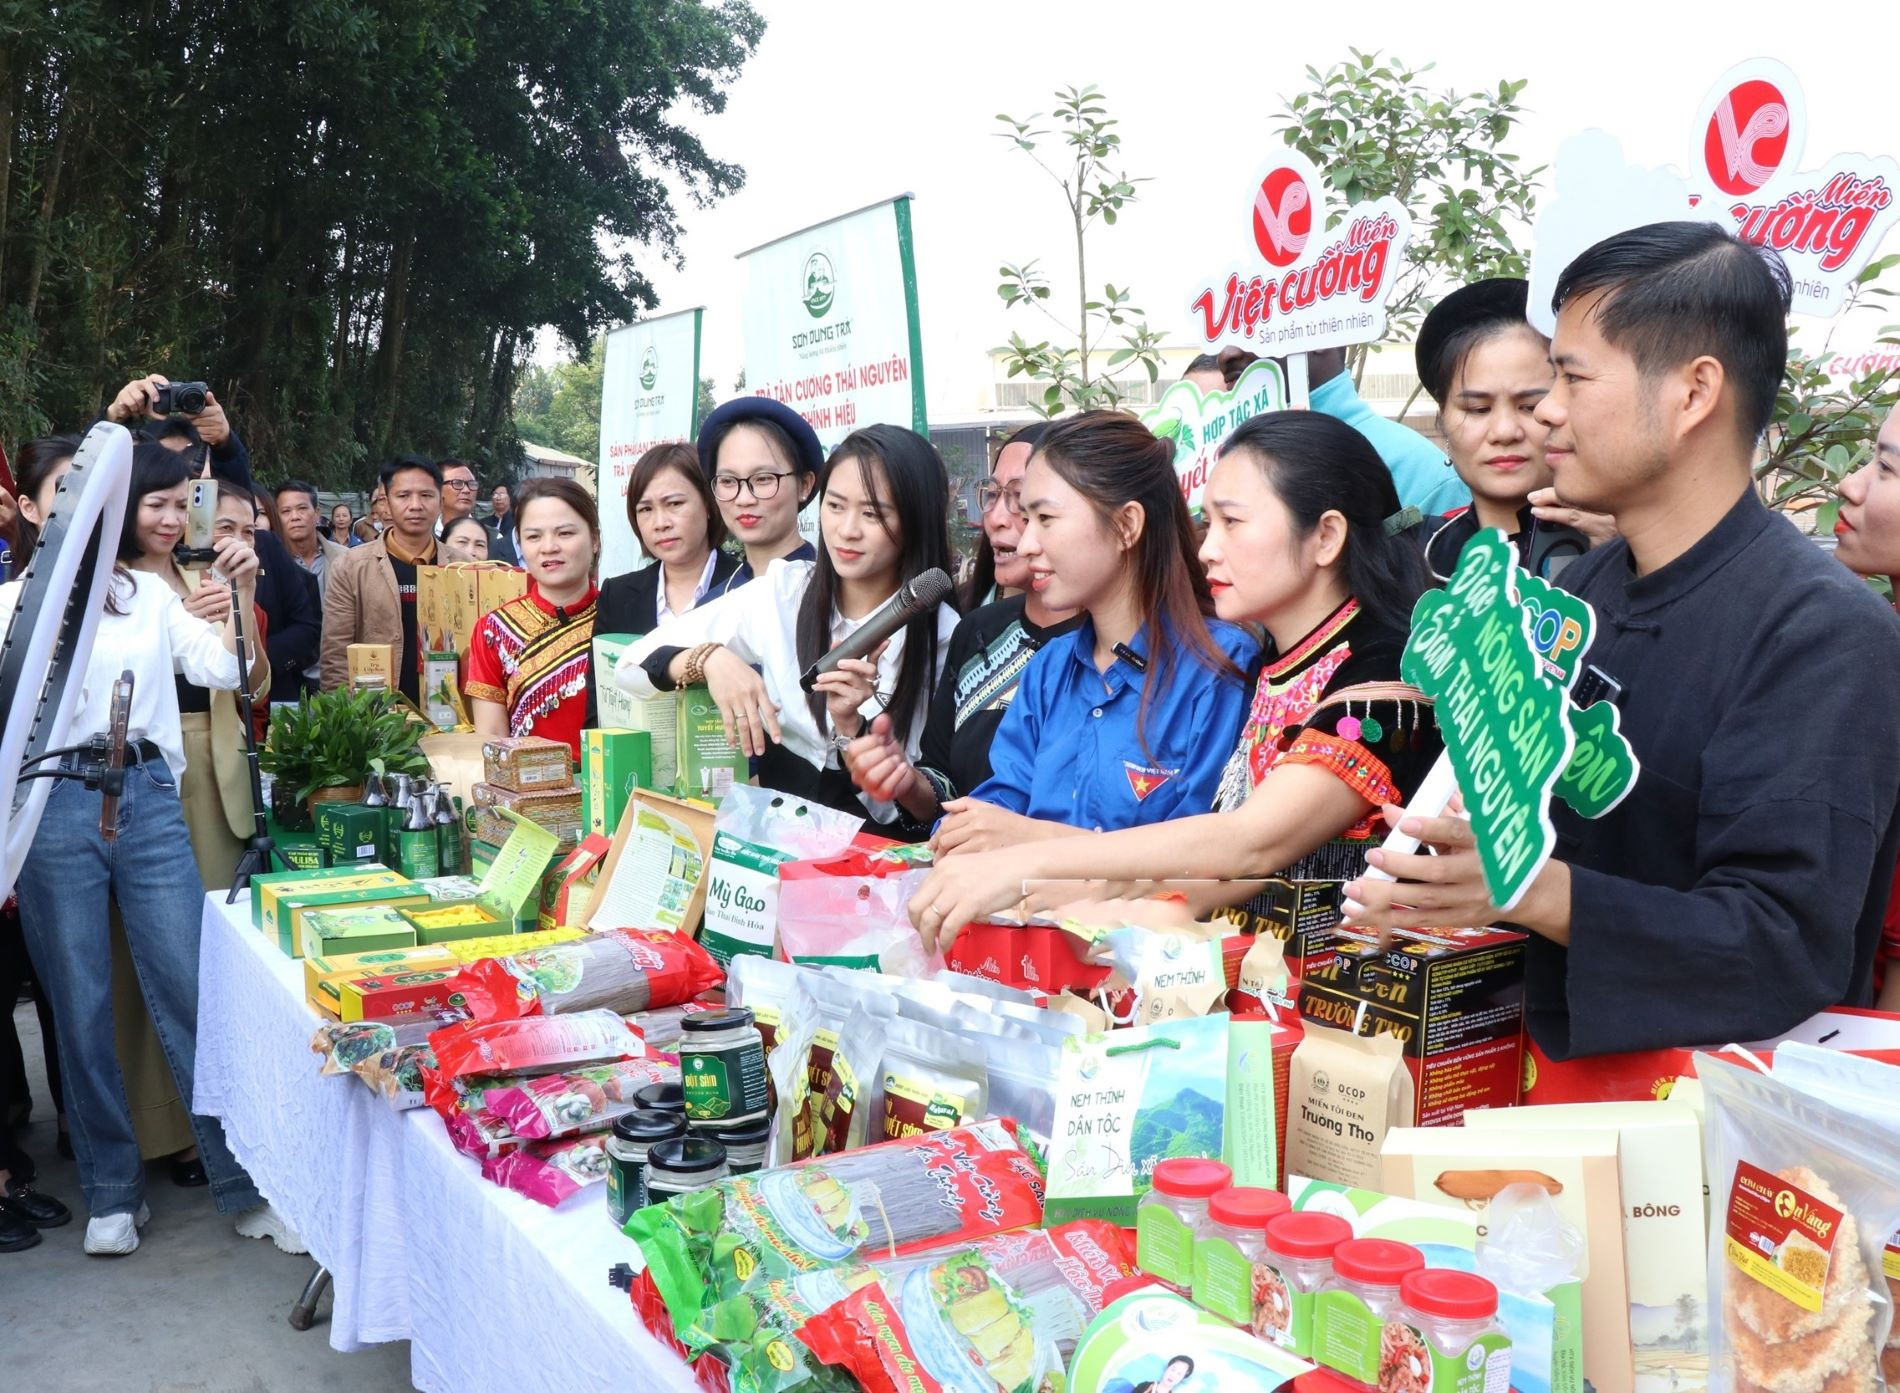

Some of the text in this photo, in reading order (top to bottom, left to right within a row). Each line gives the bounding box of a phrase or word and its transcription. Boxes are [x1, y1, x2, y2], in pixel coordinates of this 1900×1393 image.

[1807, 172, 1893, 208] Miến
[1336, 212, 1399, 249] Miến
[1192, 240, 1391, 342] Việt cường
[1258, 312, 1374, 345] Sản phẩm từ thiên nhiên
[835, 363, 857, 393] THÁI
[859, 353, 908, 387] NGUYÊN
[1203, 415, 1226, 444] HỢP
[1229, 401, 1251, 429] TÁC
[1444, 657, 1487, 747] THÁI
[1473, 611, 1554, 788] NÔNG SẢN
[1562, 724, 1622, 802] ên
[1465, 726, 1534, 885] NGUYÊN
[709, 876, 766, 915] Mỳ Gạo
[1155, 967, 1206, 989] NEM THÍNH
[928, 1103, 956, 1116] Natural
[1070, 1087, 1126, 1108] NEM THÍNH
[1308, 1097, 1329, 1110] MIẾN
[1338, 1083, 1366, 1100] OCOP
[1067, 1112, 1121, 1137] DÂN TỘC
[1301, 1104, 1375, 1146] Trường Thọ
[1064, 1148, 1097, 1182] Sán
[1632, 1202, 1681, 1218] BÔNG
[894, 1354, 917, 1375] cho
